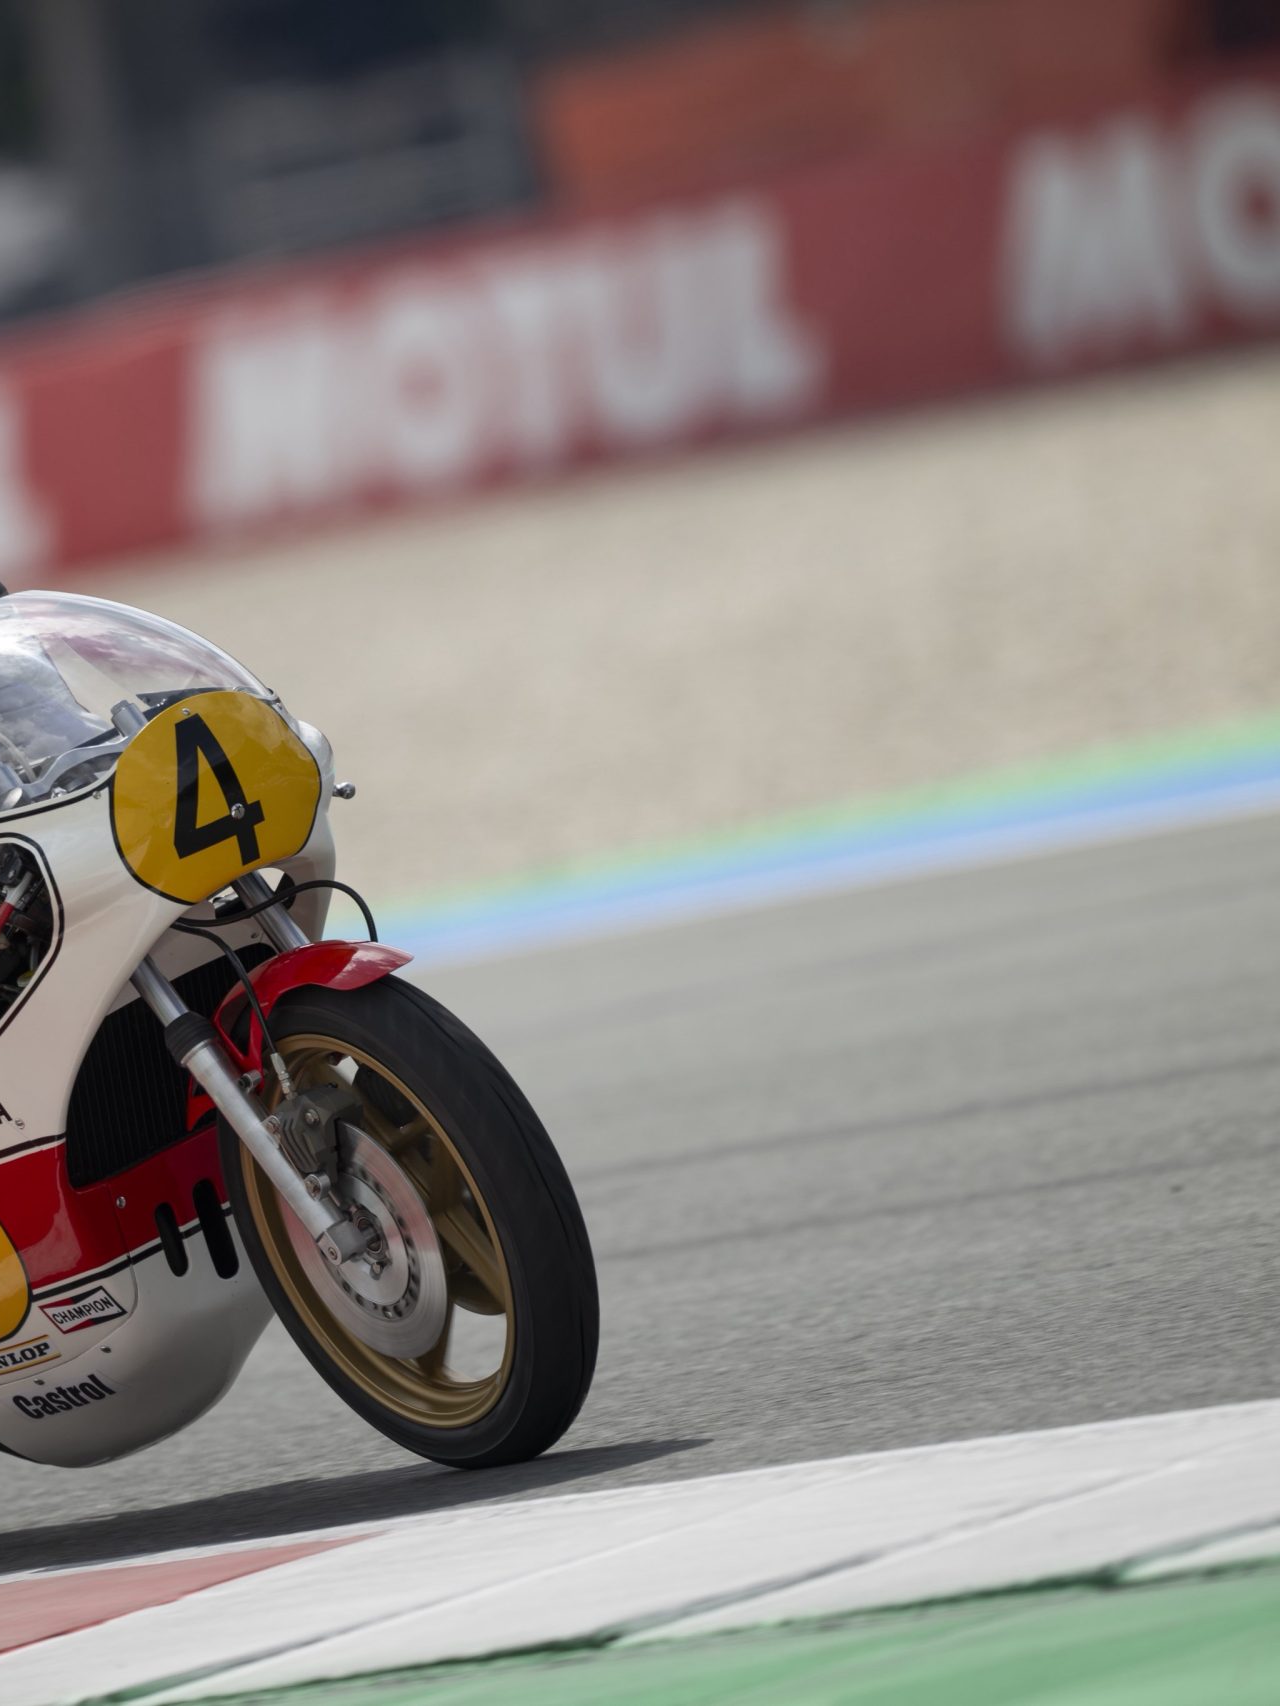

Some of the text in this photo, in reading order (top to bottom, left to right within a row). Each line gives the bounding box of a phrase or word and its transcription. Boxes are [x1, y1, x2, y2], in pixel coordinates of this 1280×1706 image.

[186, 205, 826, 545] MOTUL
[174, 713, 265, 866] 4
[52, 1297, 114, 1324] CHAMPION
[12, 1374, 116, 1420] Castrol
